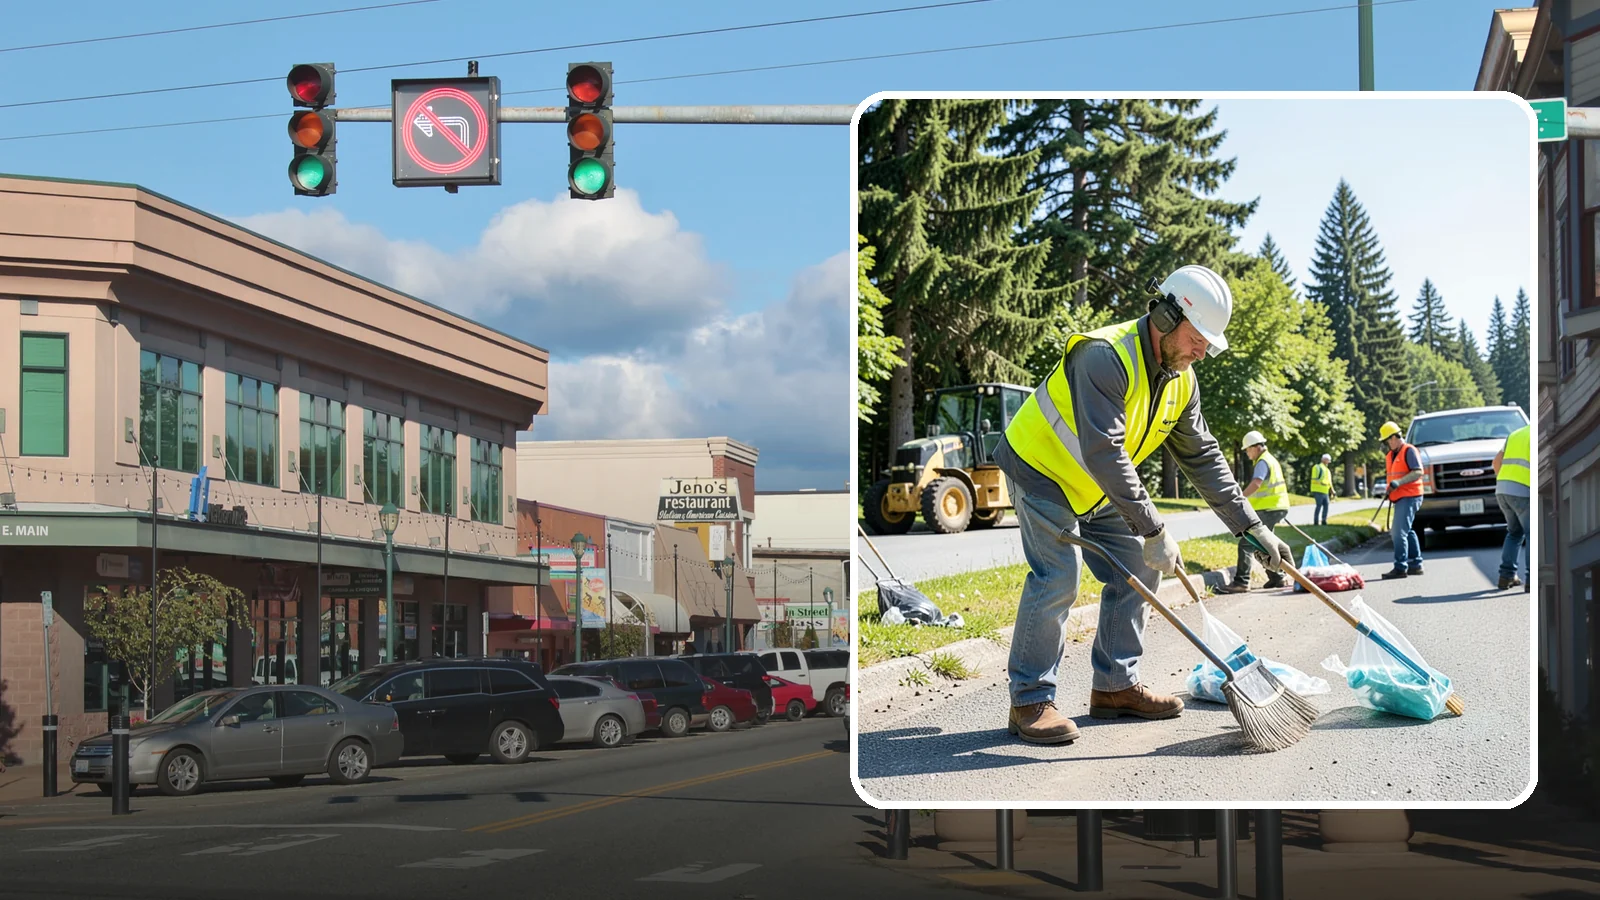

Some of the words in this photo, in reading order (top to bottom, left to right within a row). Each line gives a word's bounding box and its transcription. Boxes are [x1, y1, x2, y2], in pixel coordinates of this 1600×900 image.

[669, 480, 728, 494] Jeno's
[665, 496, 731, 509] restaurant
[685, 509, 715, 520] American
[715, 509, 738, 520] Cuisine
[2, 525, 13, 536] E.
[15, 525, 49, 536] MAIN
[797, 607, 828, 616] Street
